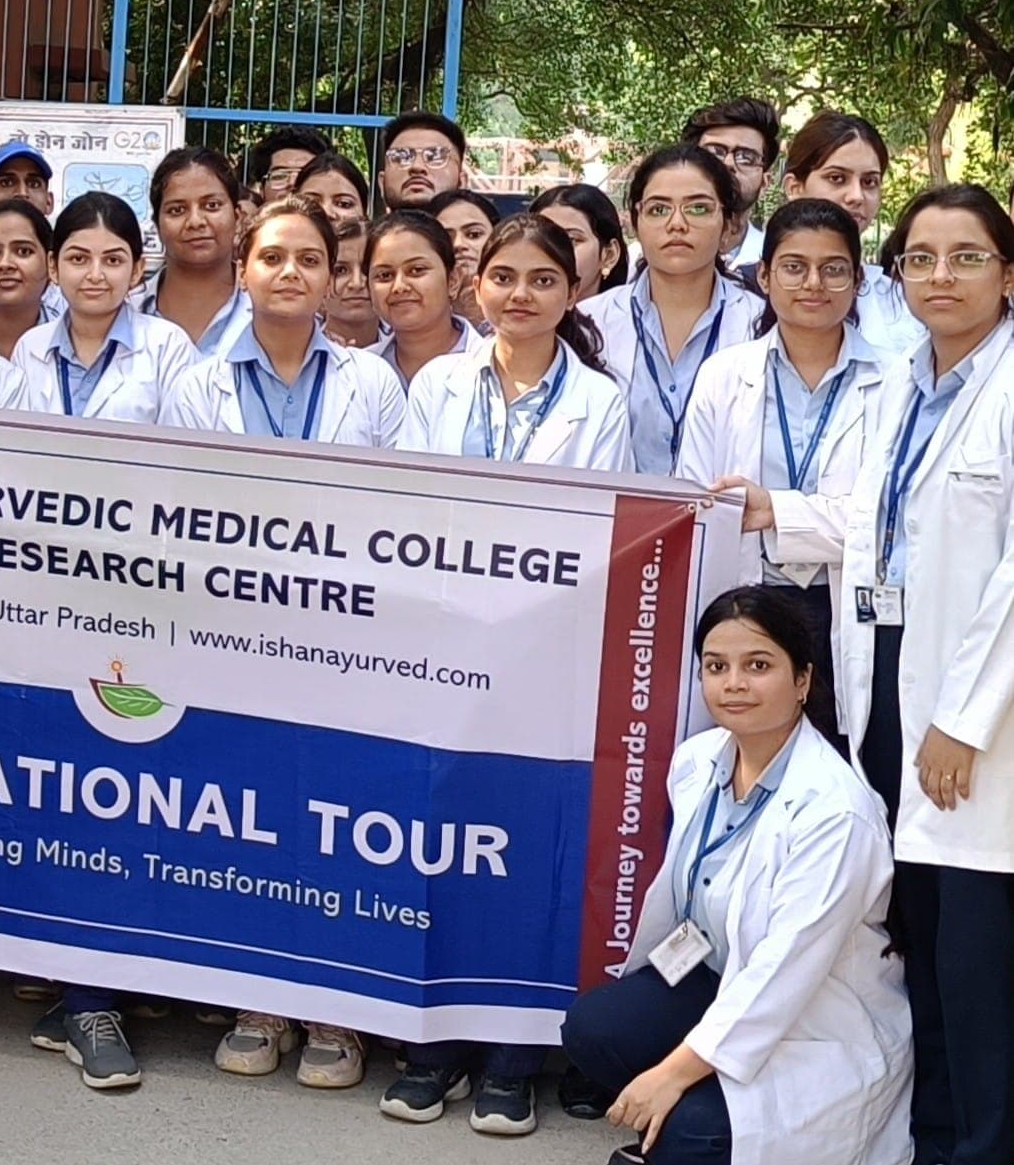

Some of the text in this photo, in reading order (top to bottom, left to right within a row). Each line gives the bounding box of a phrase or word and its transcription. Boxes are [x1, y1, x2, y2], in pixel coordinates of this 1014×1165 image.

[151, 504, 347, 558] MEDICAL
[368, 530, 581, 587] COLLEGE
[204, 566, 375, 617] CENTRE
[57, 607, 156, 640] Pradesh
[190, 629, 491, 691] www.ishanayurved.com
[604, 538, 663, 979] A Journey towards excellence...
[308, 799, 509, 877] TOUR
[36, 837, 130, 879] Minds,
[143, 854, 341, 916] Transforming
[355, 889, 431, 929] Lives
